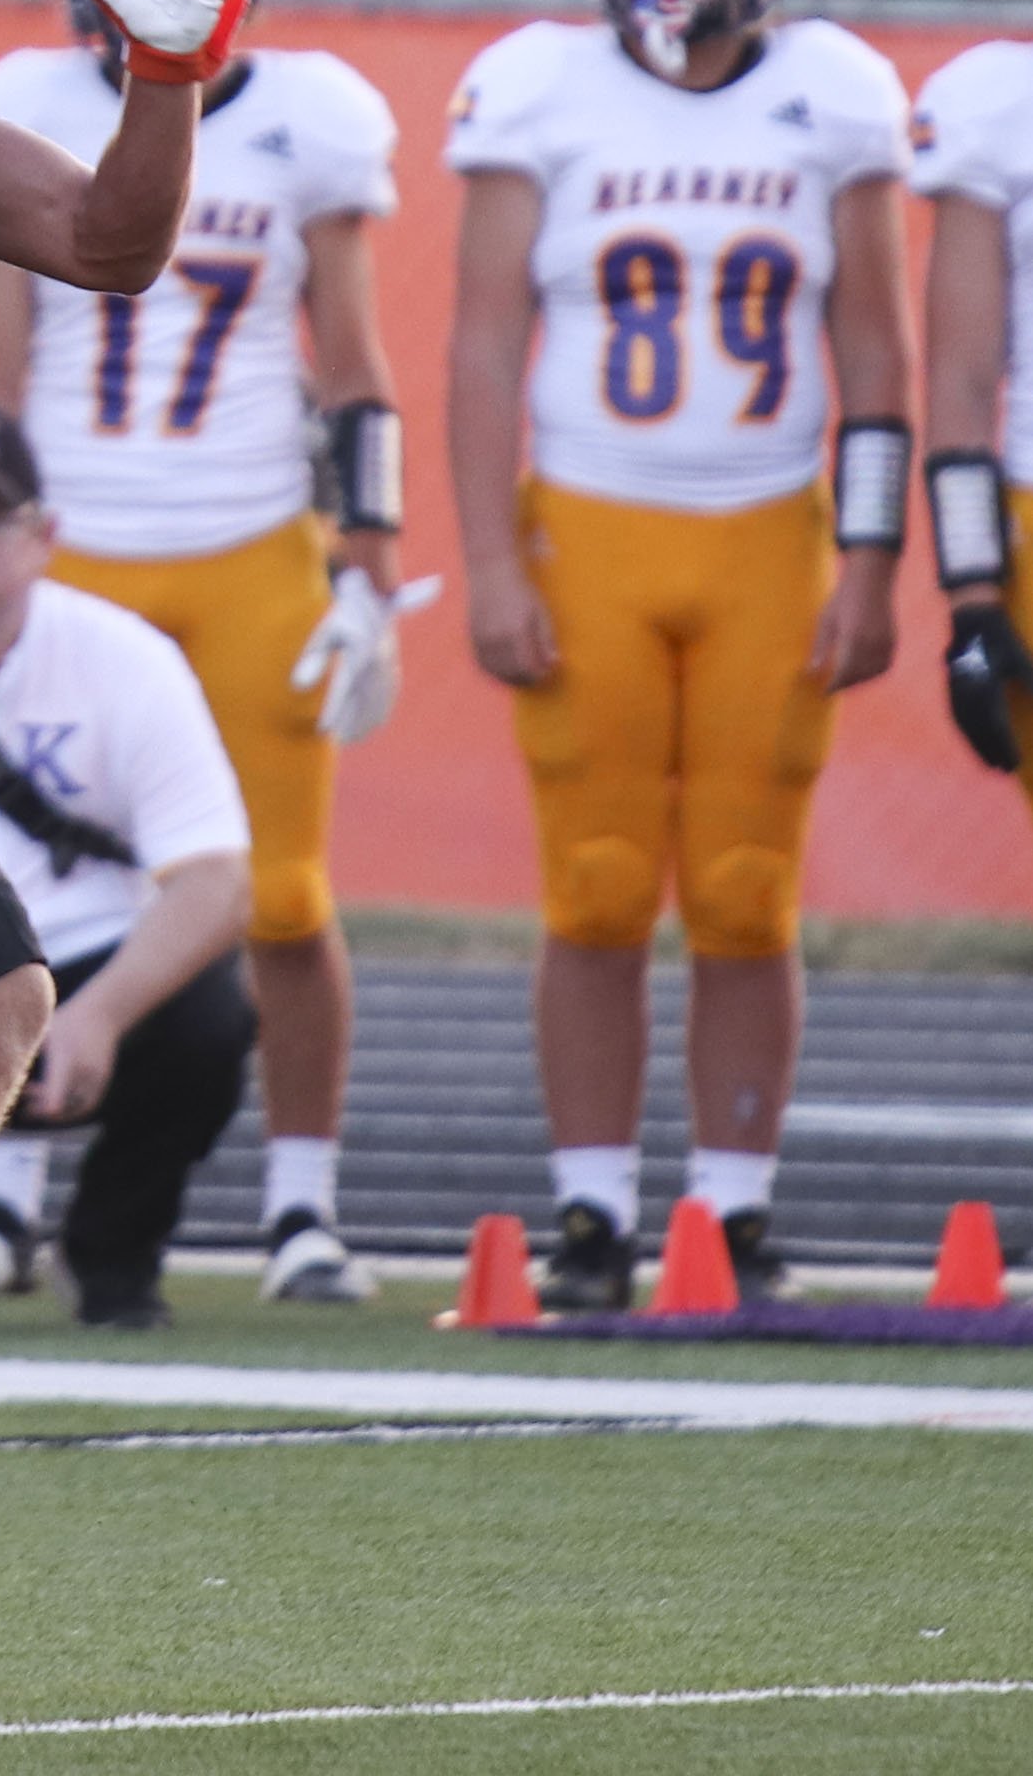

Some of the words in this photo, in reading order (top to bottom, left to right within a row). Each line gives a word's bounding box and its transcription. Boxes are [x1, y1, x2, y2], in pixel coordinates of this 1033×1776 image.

[94, 256, 267, 436] 17
[595, 229, 803, 425] 89
[20, 722, 87, 797] K
